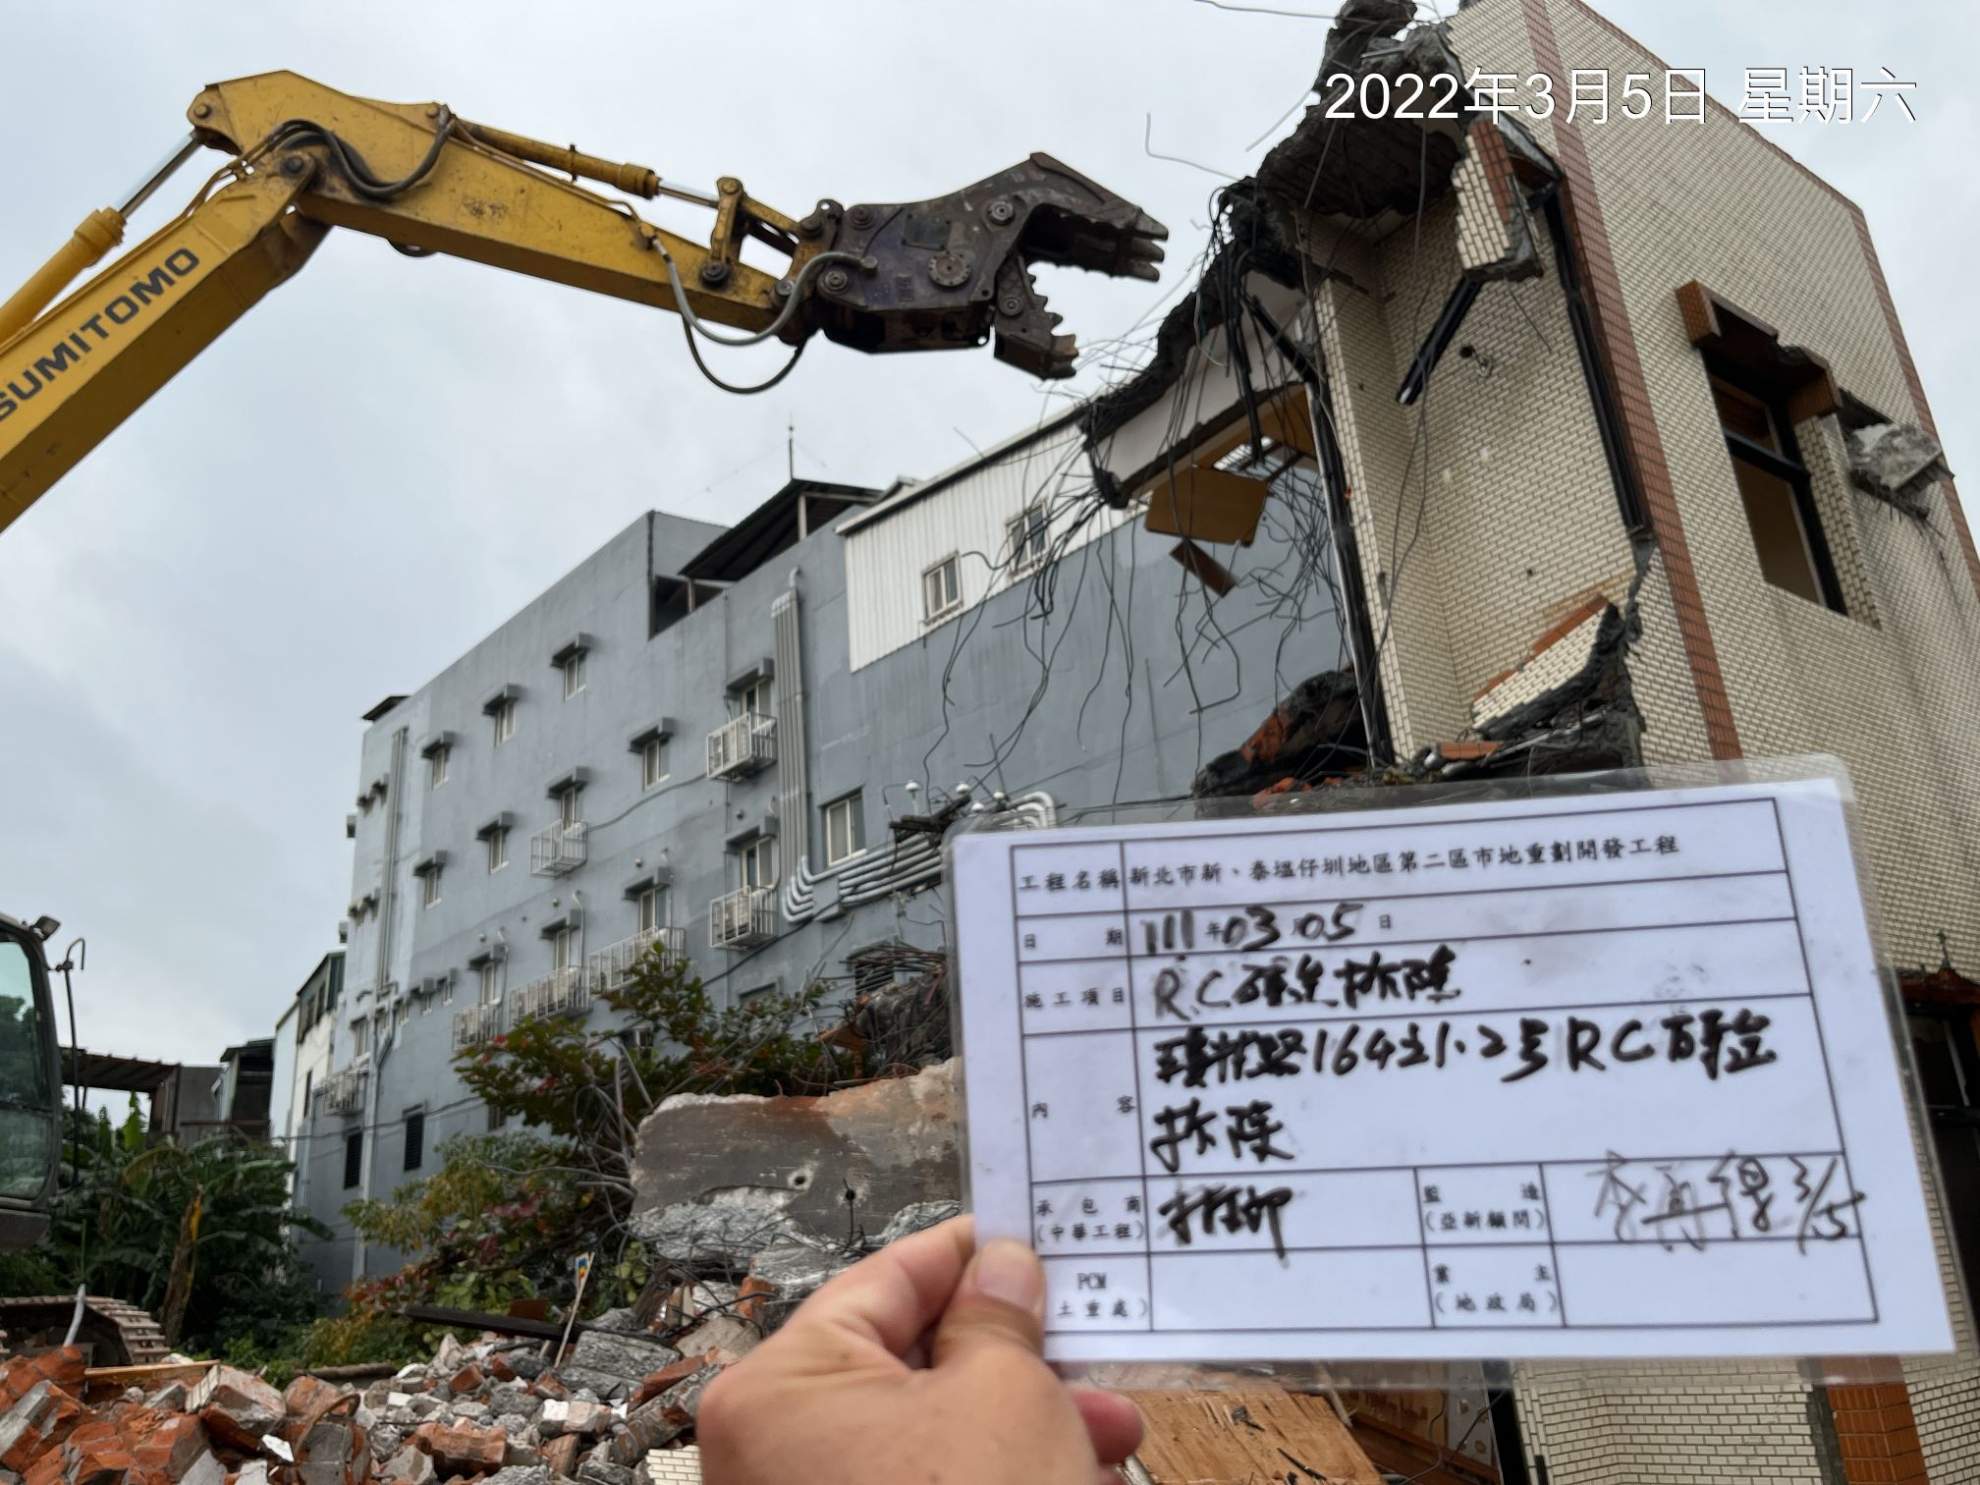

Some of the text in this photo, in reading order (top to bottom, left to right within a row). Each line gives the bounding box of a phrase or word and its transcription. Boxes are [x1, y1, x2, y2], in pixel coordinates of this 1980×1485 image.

[0, 247, 200, 422] SUMITOMO
[1019, 868, 1121, 891] 工程名稱
[1077, 1271, 1107, 1292] PCM
